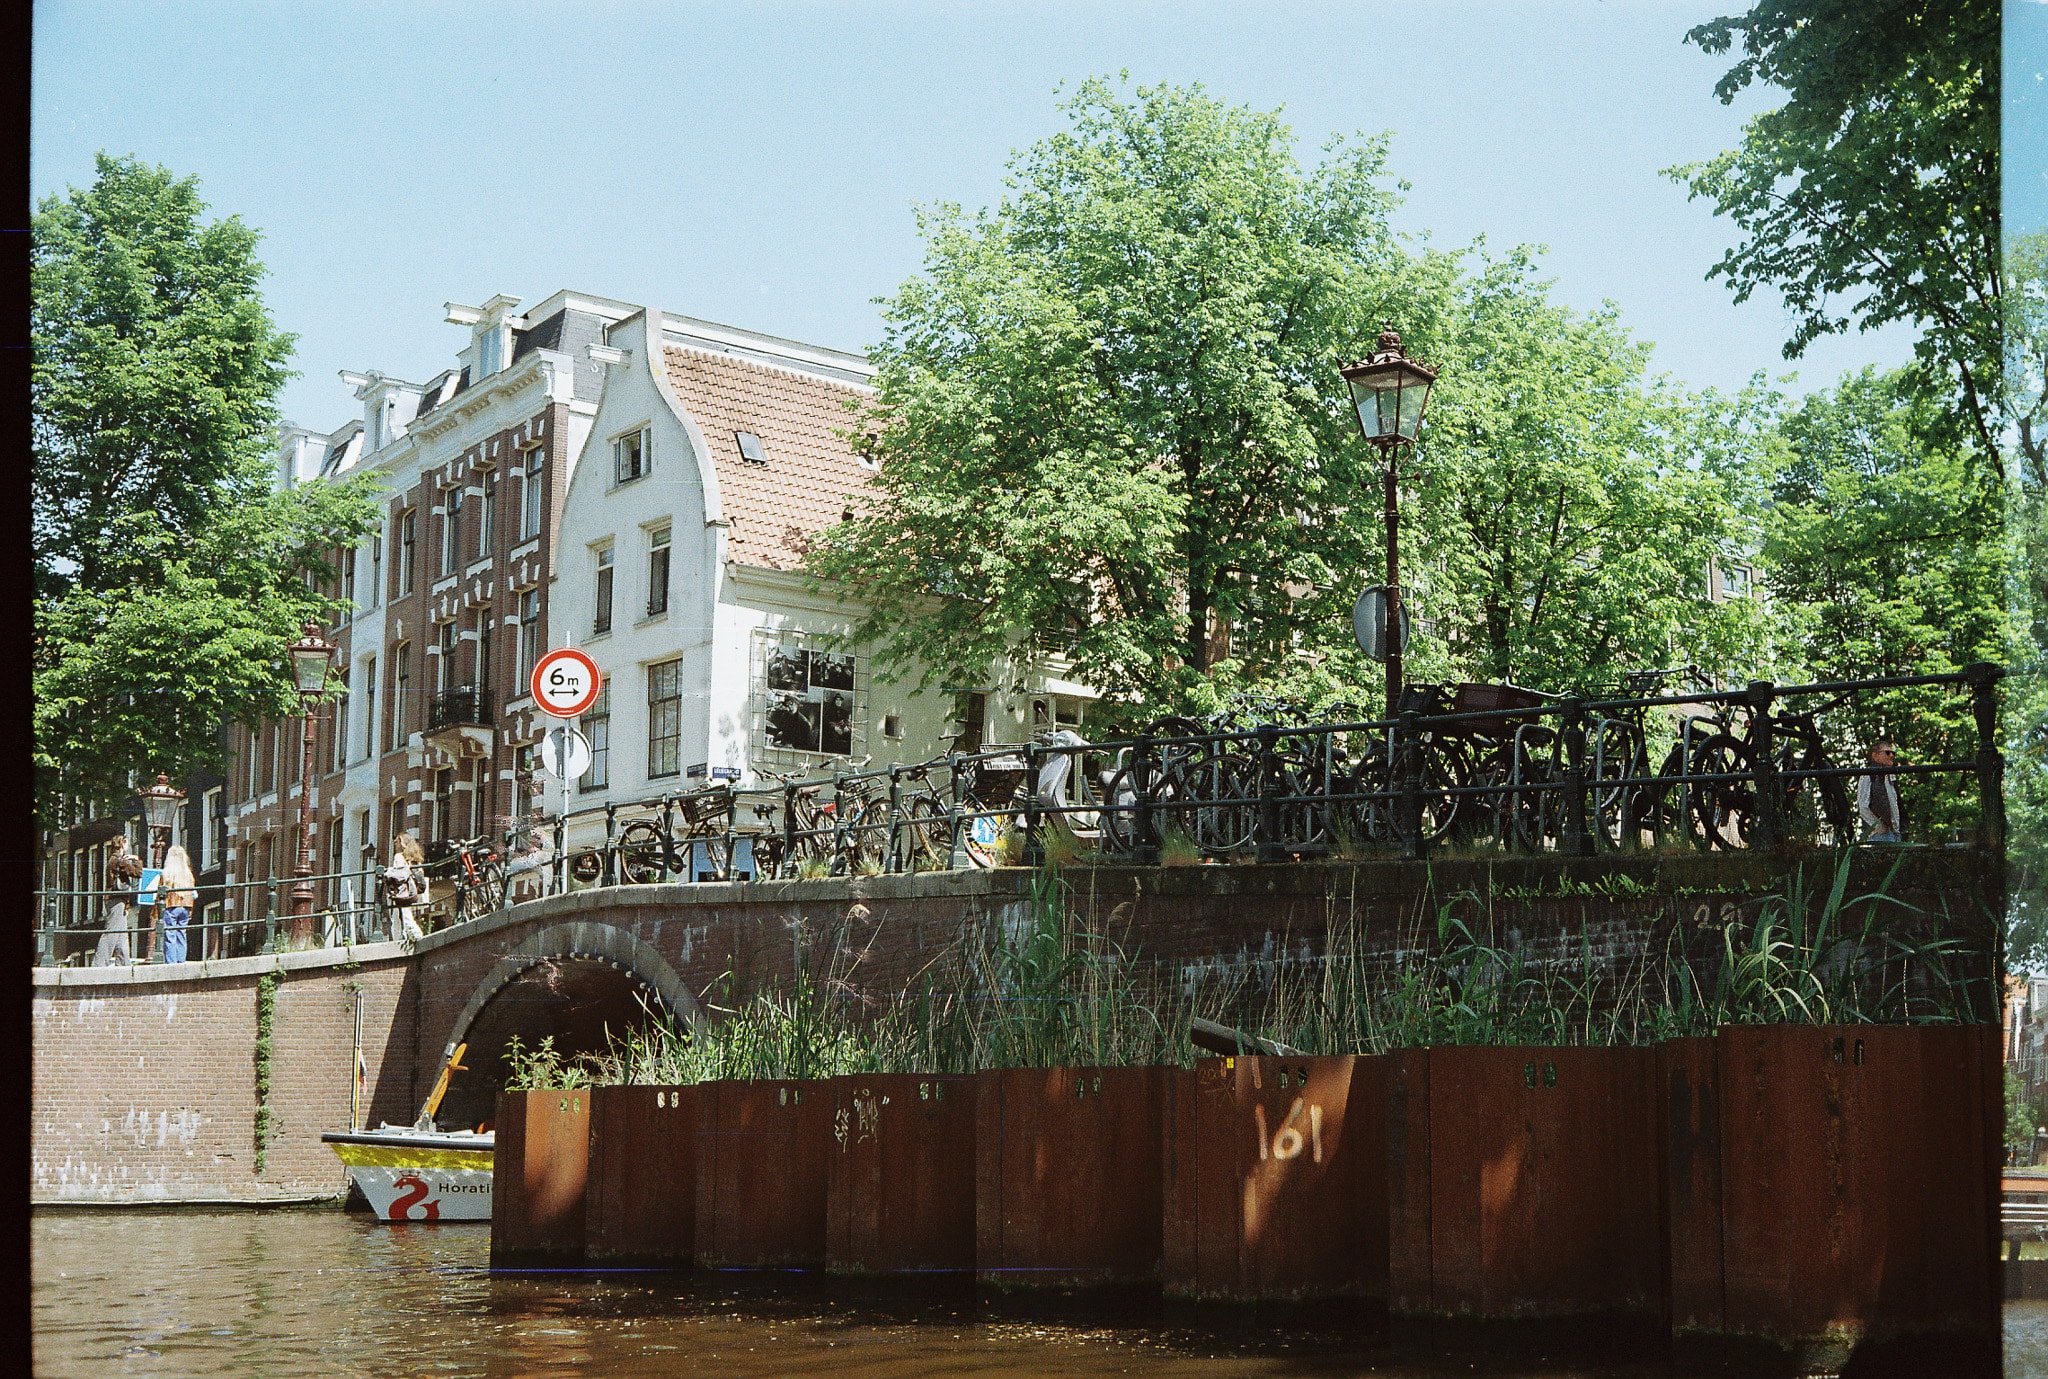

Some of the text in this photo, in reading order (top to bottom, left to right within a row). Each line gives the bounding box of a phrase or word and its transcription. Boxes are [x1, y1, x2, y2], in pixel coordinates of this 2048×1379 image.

[550, 667, 579, 686] 6 m
[438, 1182, 493, 1194] Horati
